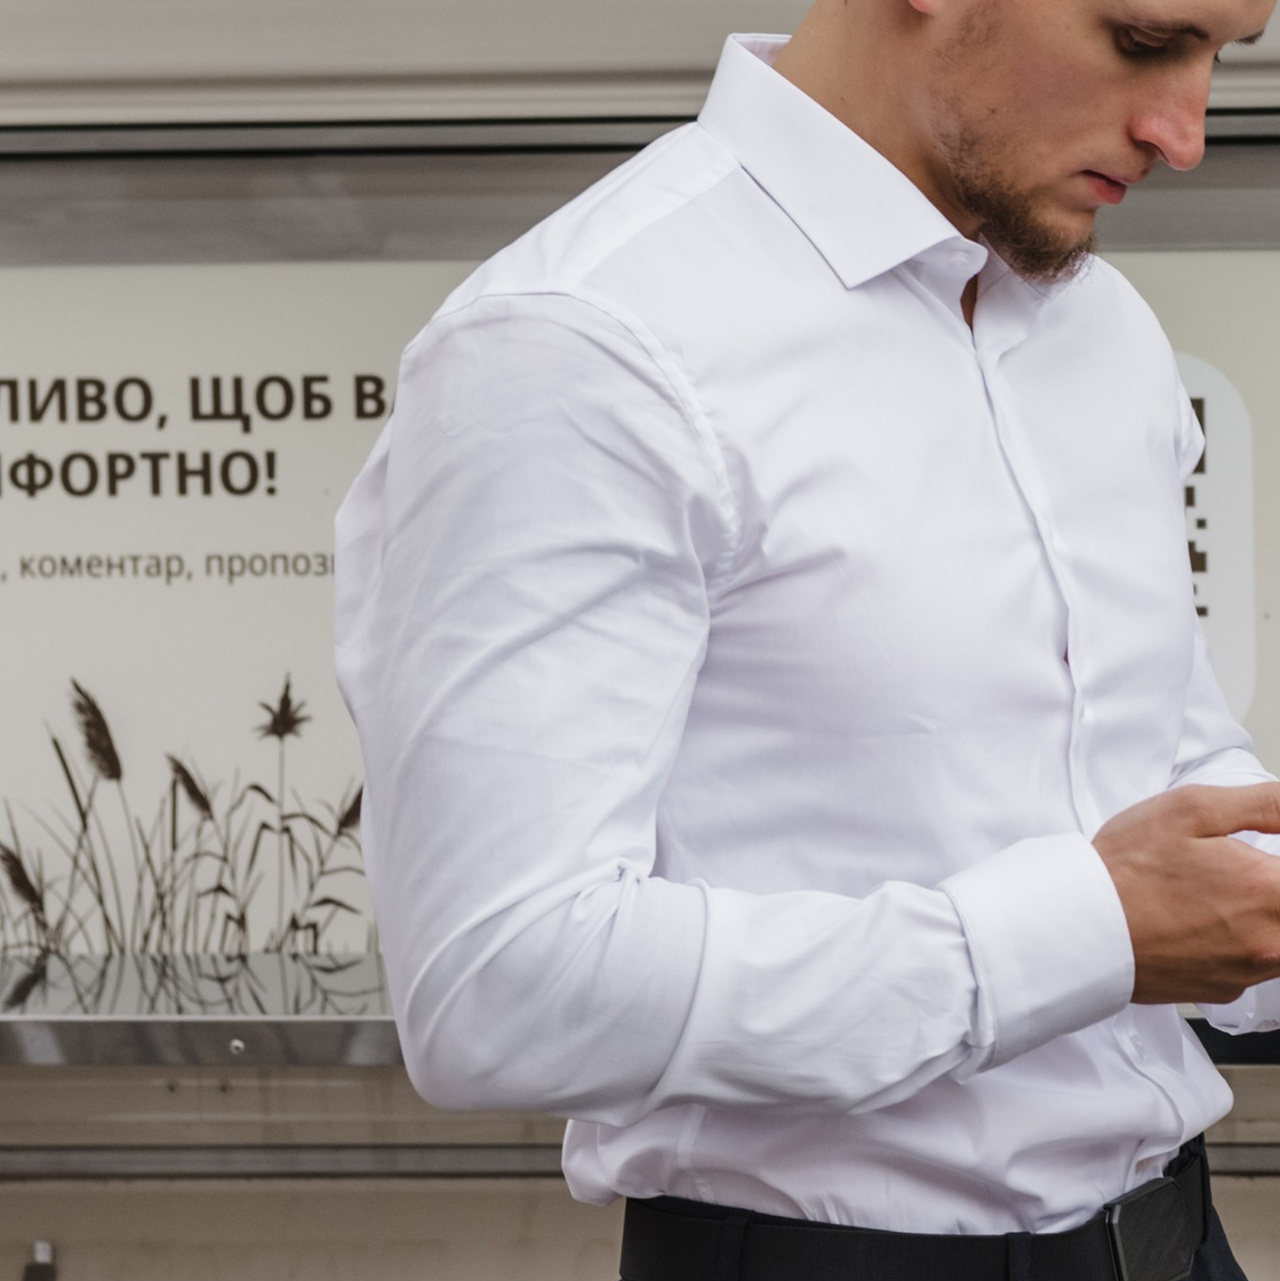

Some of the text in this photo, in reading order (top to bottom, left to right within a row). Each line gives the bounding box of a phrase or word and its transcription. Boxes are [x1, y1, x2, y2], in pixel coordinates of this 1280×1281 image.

[189, 375, 332, 433] ЩОБ
[0, 451, 277, 498] ФОРТНО!
[20, 553, 193, 586] коментар,
